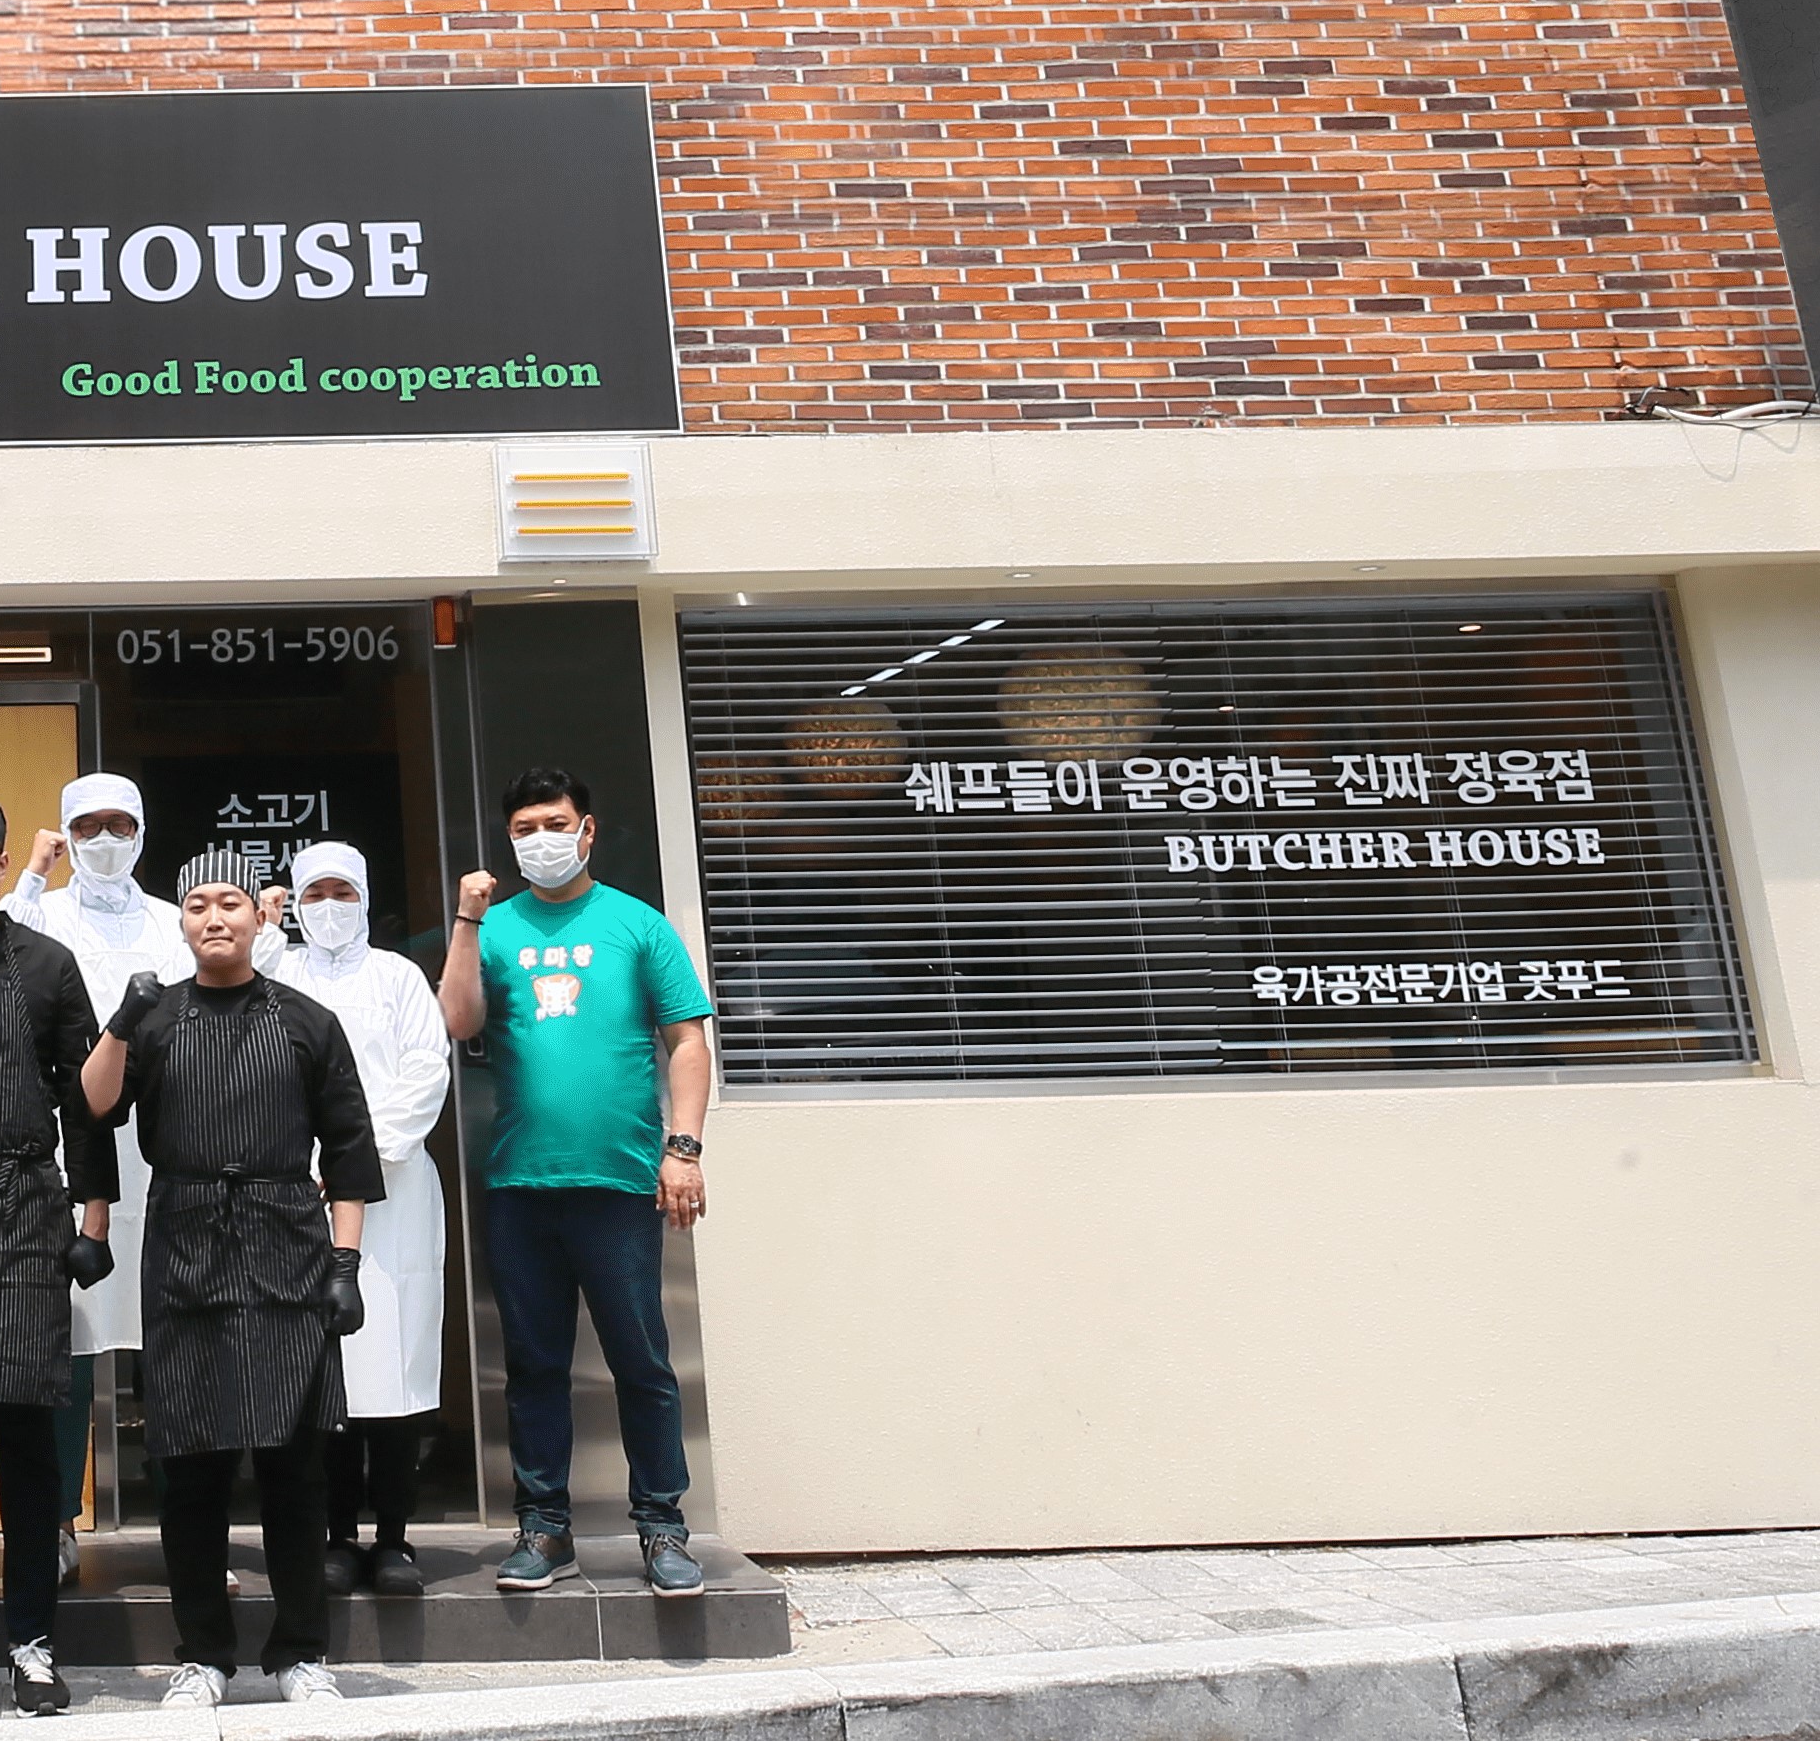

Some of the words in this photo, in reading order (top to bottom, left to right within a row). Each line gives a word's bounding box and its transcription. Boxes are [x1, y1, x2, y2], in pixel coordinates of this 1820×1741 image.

[25, 221, 429, 303] HOUSE
[61, 360, 181, 396] Good
[193, 357, 307, 394] Food
[318, 354, 601, 401] cooperation
[117, 625, 399, 664] 051-851-5906
[904, 759, 1103, 814] 쉐프들이
[1121, 755, 1317, 809] 운영하는
[1331, 752, 1431, 806] 진짜
[1445, 749, 1596, 805] 정육점
[216, 790, 330, 831] 소고기
[1164, 832, 1418, 873] BUTCHER
[1424, 828, 1606, 867] HOUSE
[1251, 962, 1508, 1007] 육가공전문기업
